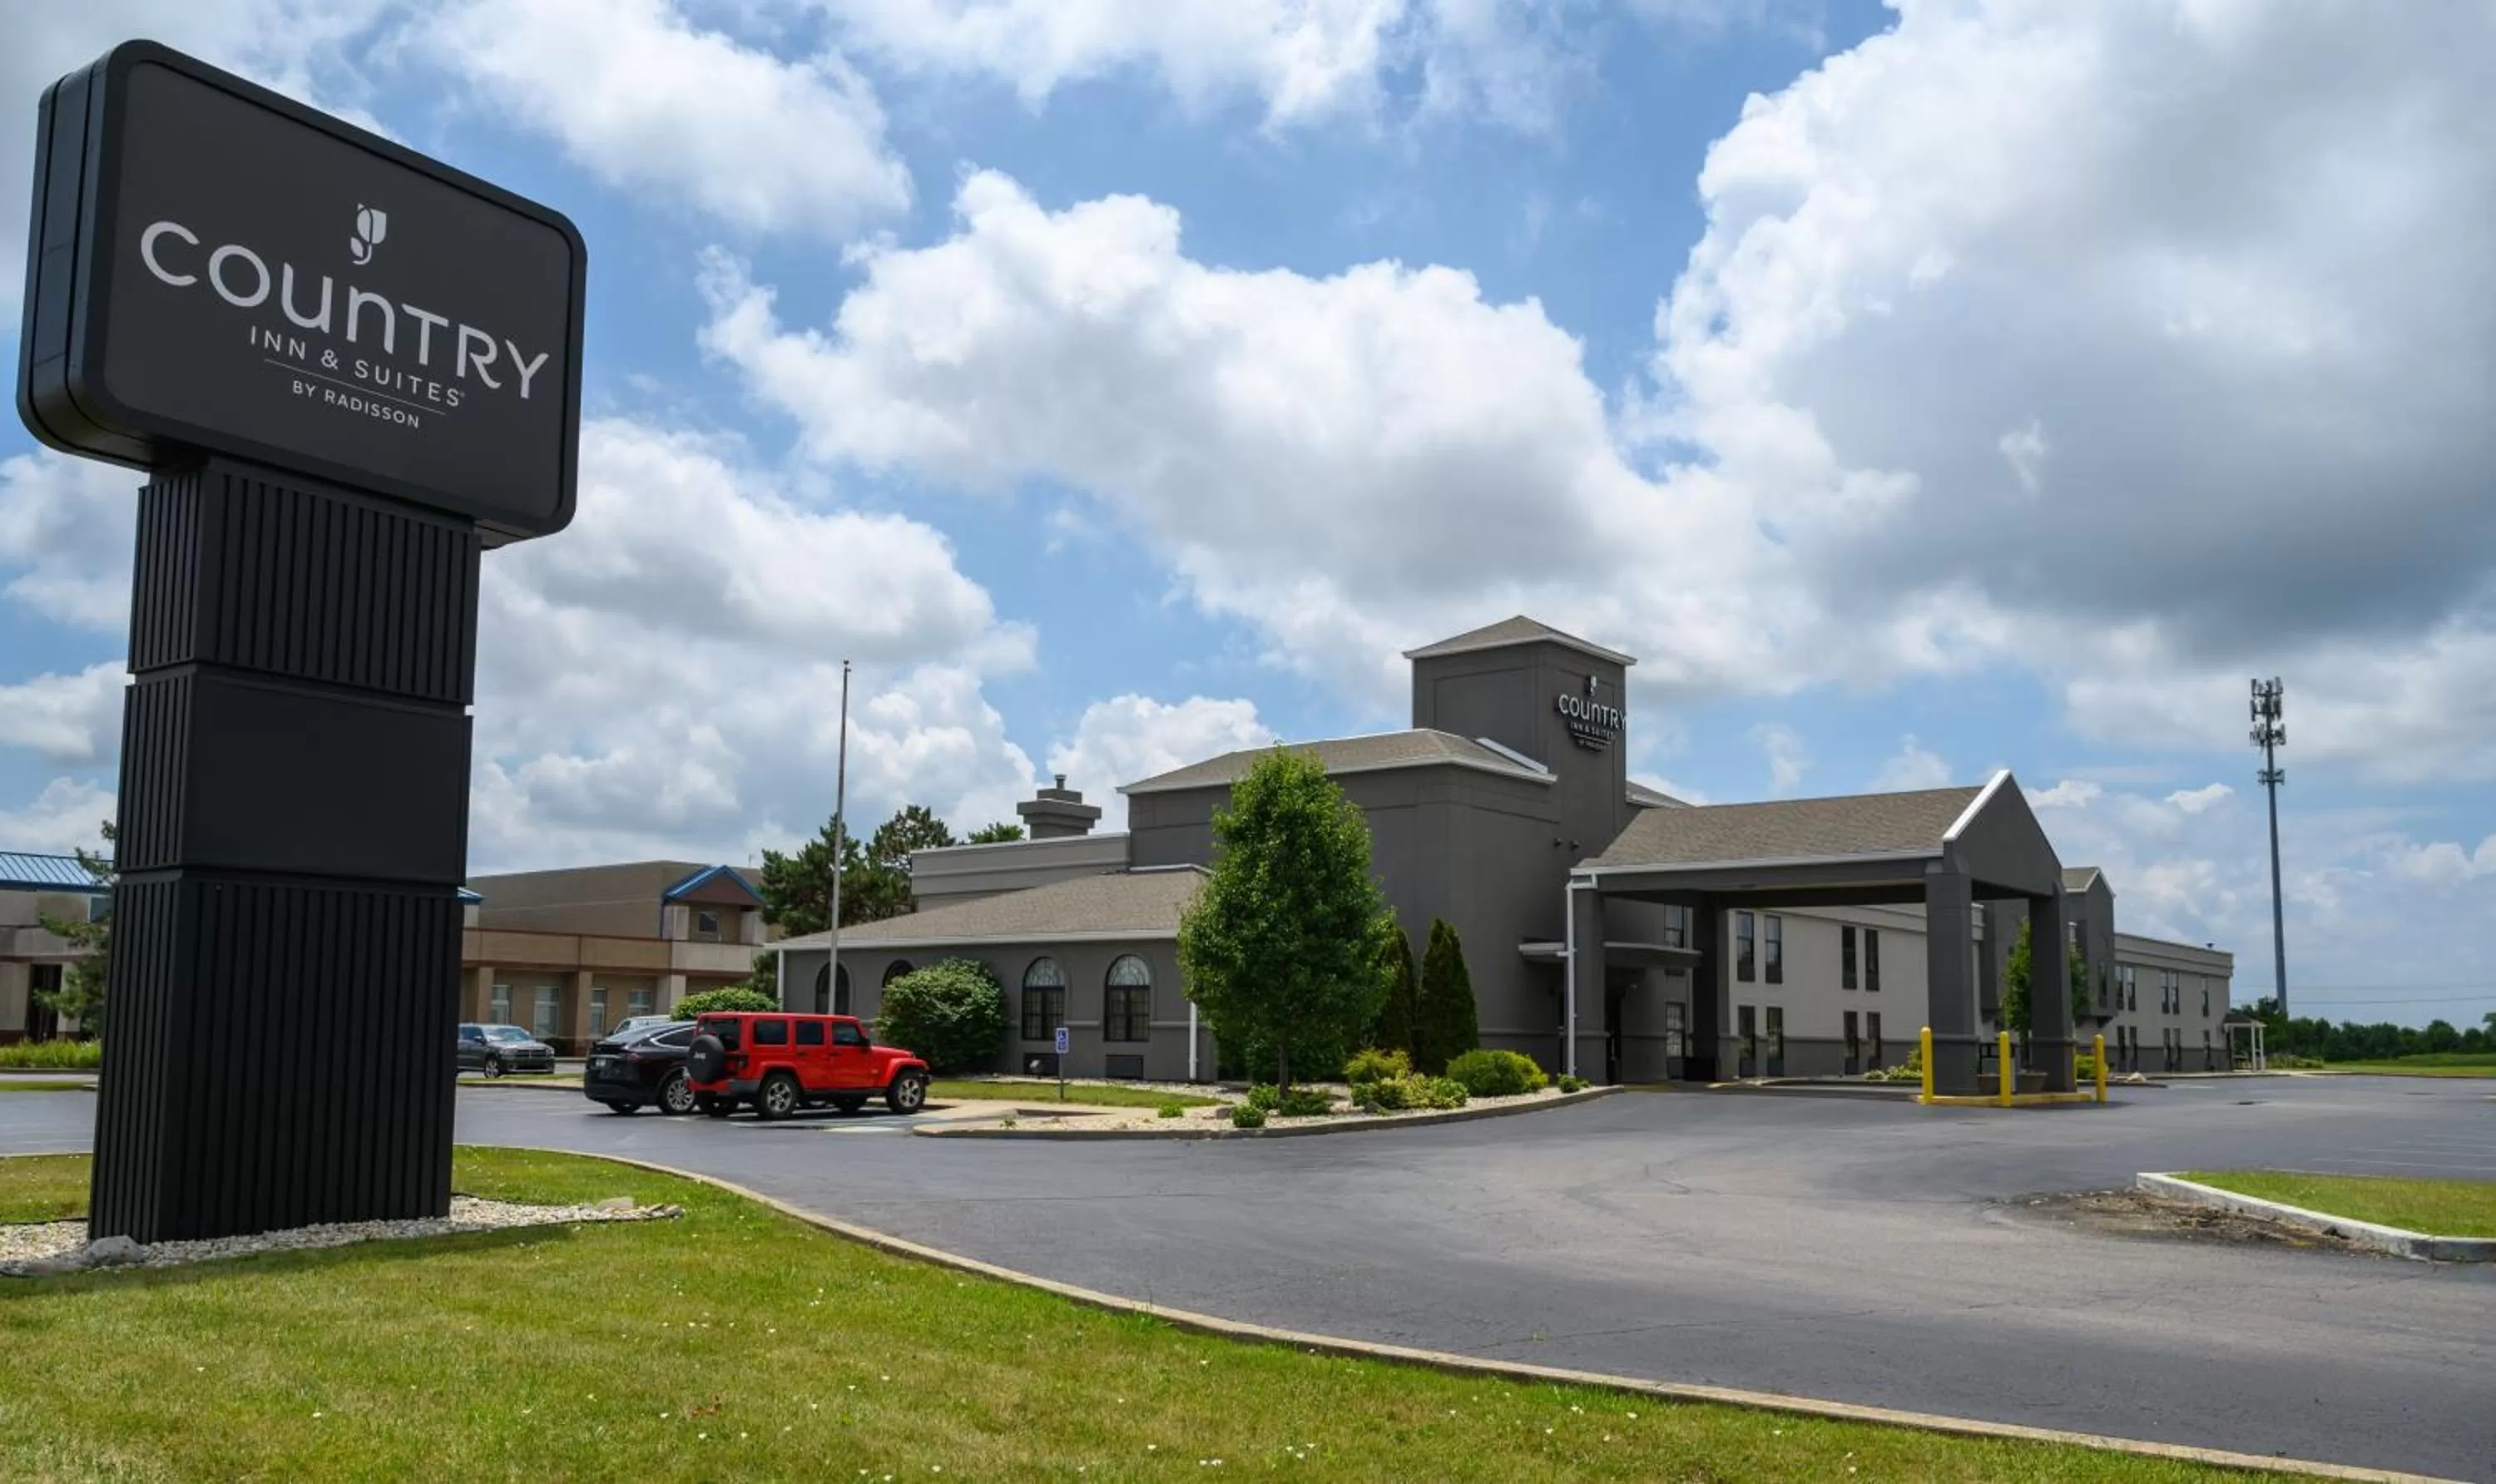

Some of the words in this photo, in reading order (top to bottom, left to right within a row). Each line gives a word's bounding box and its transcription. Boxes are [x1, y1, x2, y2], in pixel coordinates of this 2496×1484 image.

[141, 220, 549, 399] COUNTRY
[250, 325, 306, 360] INN
[320, 349, 339, 370] &
[354, 359, 459, 407] SUITES
[293, 380, 316, 398] BY
[324, 388, 419, 429] RADISSON
[1558, 694, 1626, 730] COUNTRY
